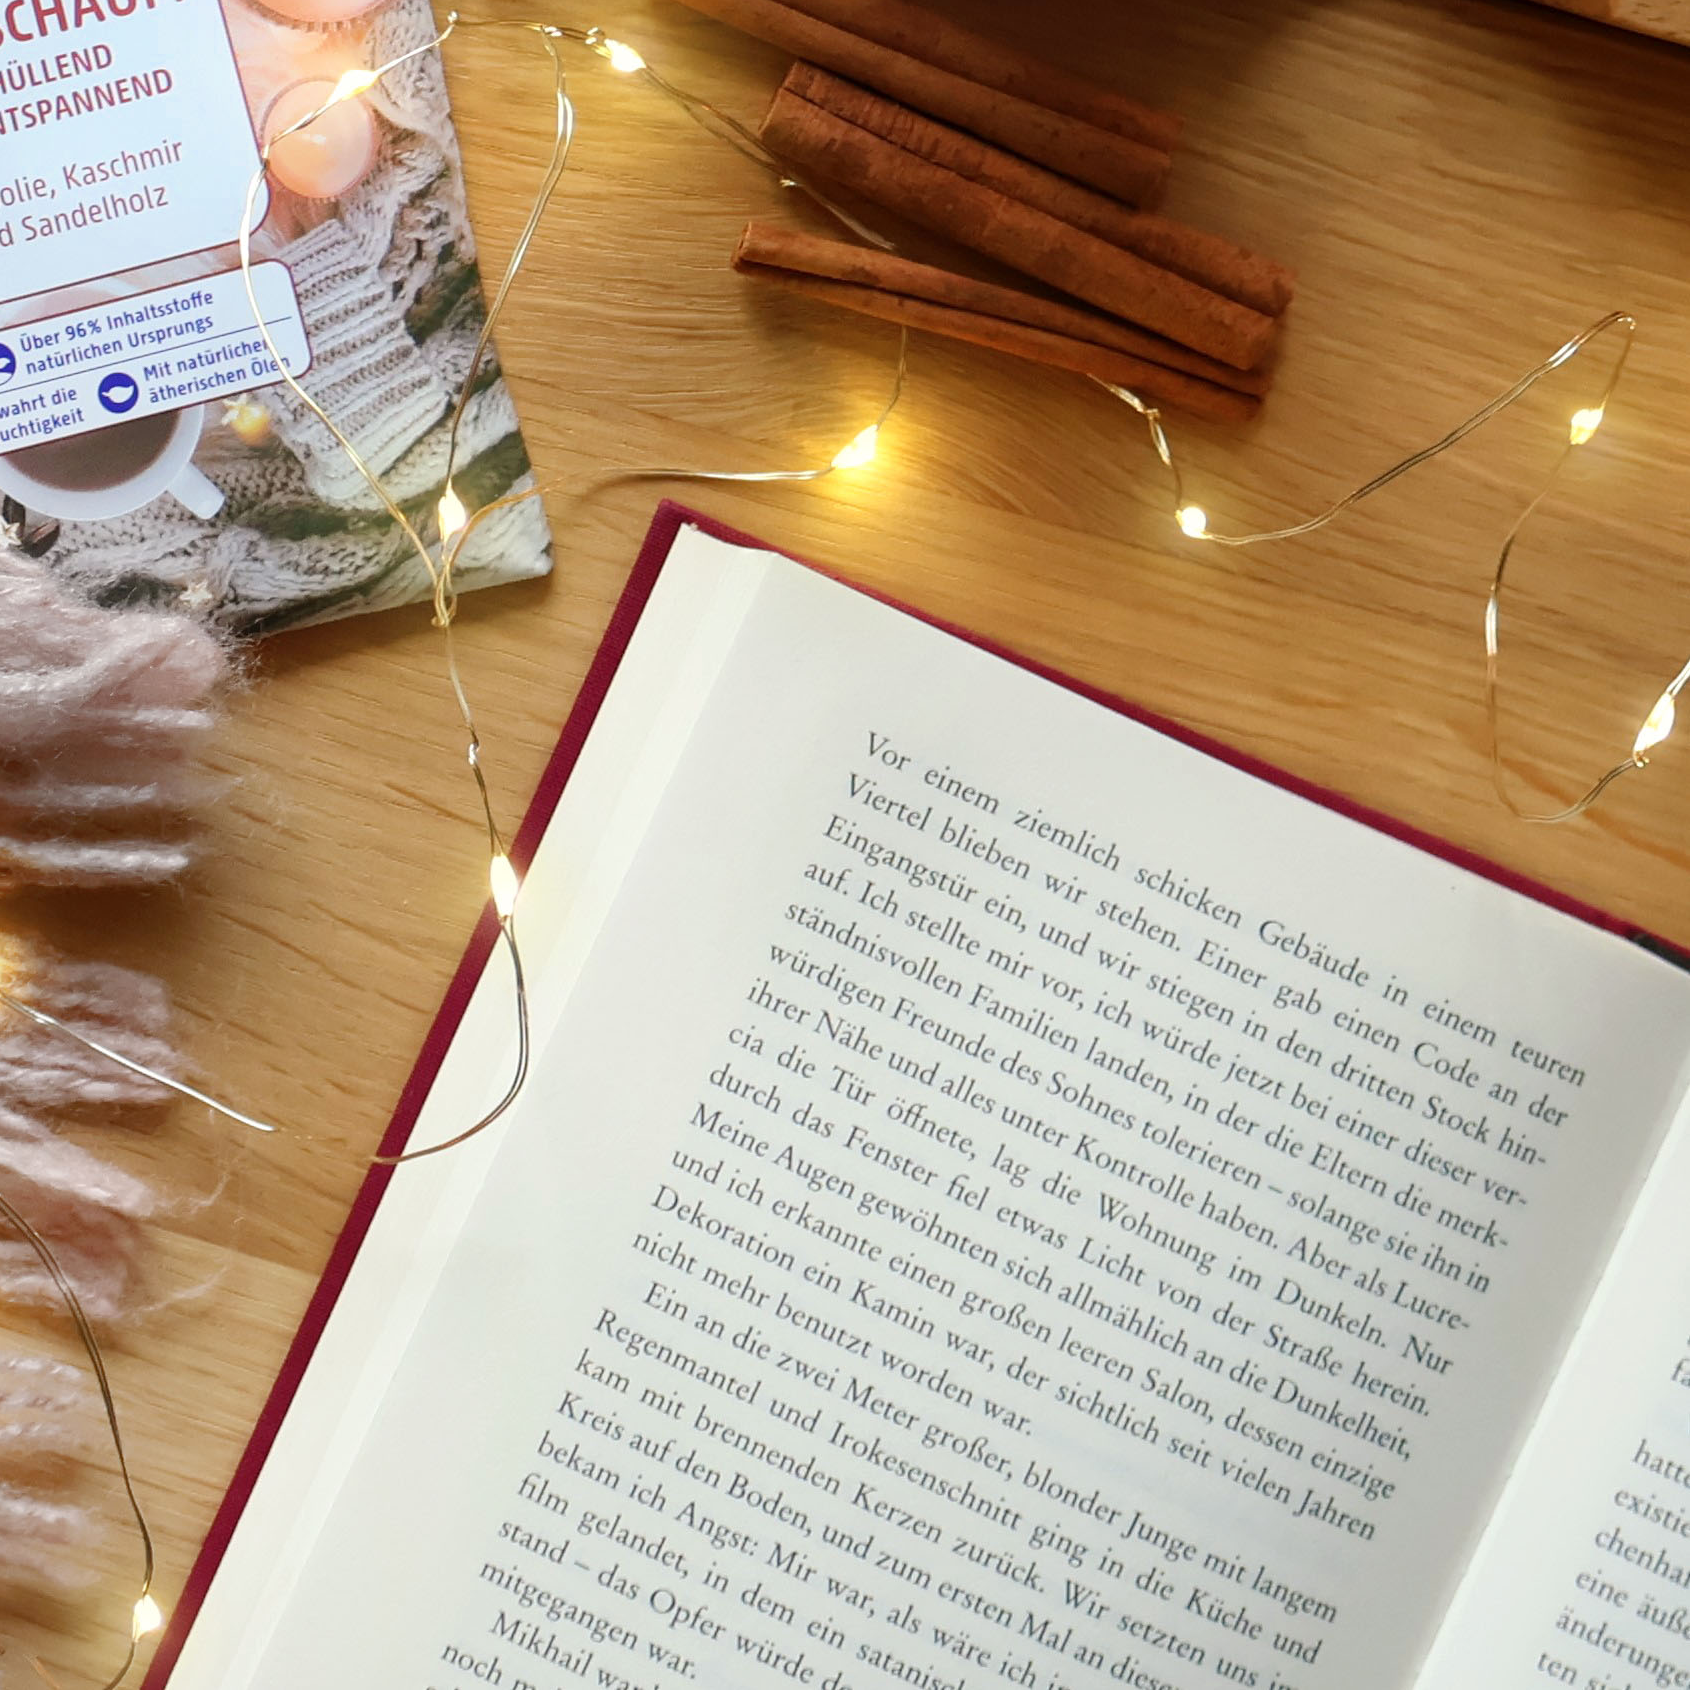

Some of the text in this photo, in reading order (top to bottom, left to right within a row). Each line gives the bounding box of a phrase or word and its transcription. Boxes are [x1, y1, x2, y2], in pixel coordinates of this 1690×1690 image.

[21, 185, 169, 241] Sandelholz
[63, 138, 183, 191] Kaschmir
[19, 331, 60, 352] Über
[106, 290, 214, 331] Inhaltsstoffe
[26, 315, 214, 375] natürlichen Ursprungs
[51, 387, 77, 406] die
[143, 338, 269, 382] Mit natürliche
[149, 366, 247, 404] ätherischen
[822, 813, 1547, 1166] Eingangstür ein, und wir stiegen in den dritten Stock hin-
[849, 771, 1570, 1127] Viertel blieben wir stehen. Einer gab einen Code an der
[868, 730, 1586, 1088] Vor einem ziemlich schicken Gebäude in einem teuren
[784, 903, 1509, 1248] ständnisvollen Familien landen, in der die Eltern die merk-
[803, 863, 1527, 1206] auf. Ich stellte mir vor, ich würde jetzt bei einer dieser ver-
[708, 1061, 1430, 1417] durch das Fenster fiel etwas Licht von der Straße herein.
[746, 977, 1470, 1331] ihrer Nähe und alles unter Kontrolle haben. Aber als Lucre-
[631, 1231, 1032, 1437] nicht mehr benutzt worden war.
[650, 1183, 1376, 1541] Dekoration ein Kamin war, der sichtlich seit vielen Jahren
[688, 1101, 1411, 1462] Meine Augen gewöhnten sich allmählich an die Dunkelheit,
[517, 1472, 846, 1650] film gelandet, in dem ein
[536, 1429, 1037, 1688] bekam ich Angst: Mir war, als wäre ich
[593, 1307, 1324, 1665] Regenmantel und Irokesenschnitt ging in die Küche und
[479, 1562, 696, 1680] mitgegangen war.
[489, 1609, 595, 1678] Mikhail
[1537, 1652, 1577, 1685] ten
[1574, 1569, 1629, 1608] eine
